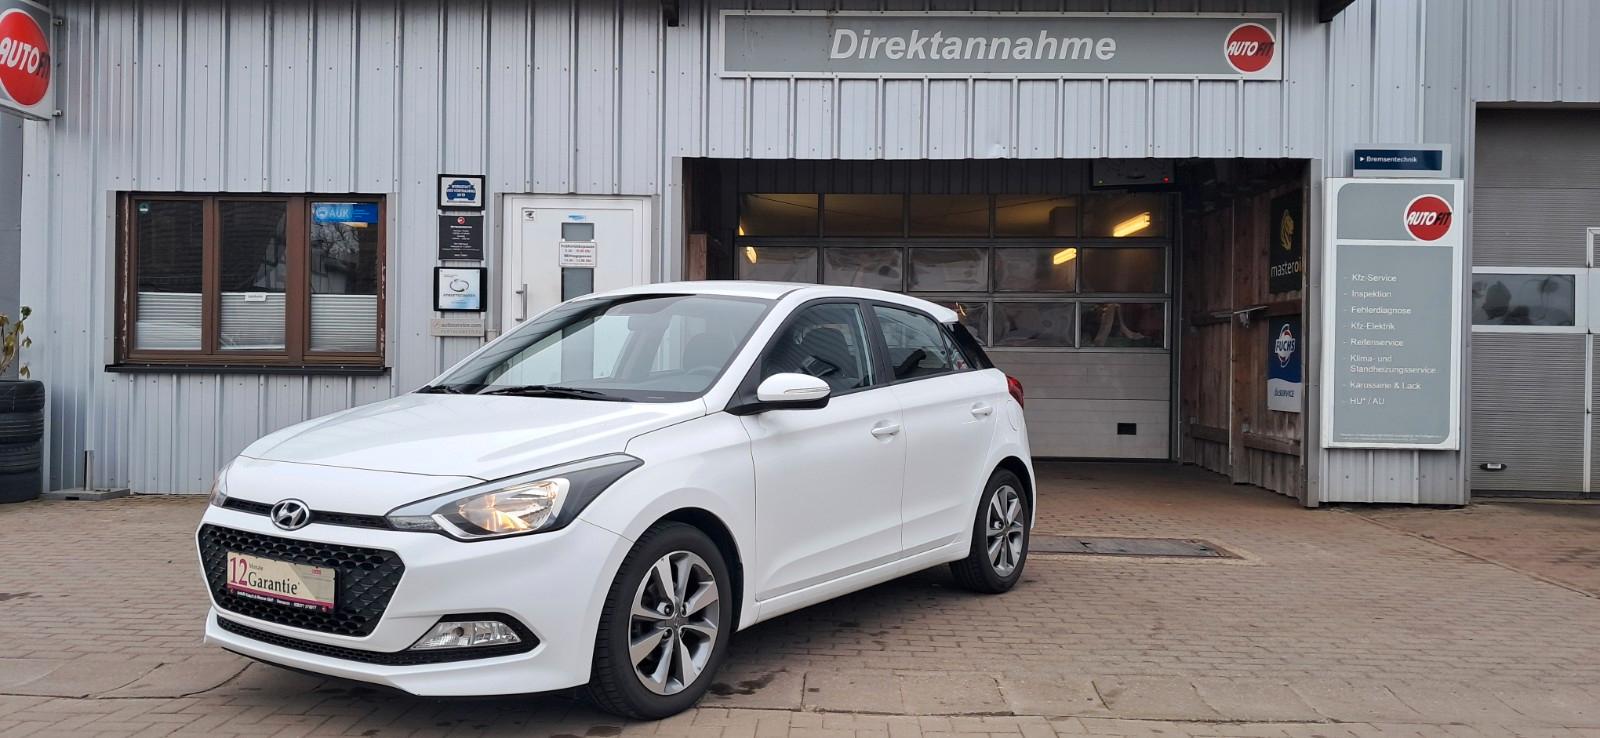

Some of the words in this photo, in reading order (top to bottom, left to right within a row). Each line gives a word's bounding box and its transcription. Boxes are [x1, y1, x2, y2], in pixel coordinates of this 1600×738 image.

[831, 28, 1117, 60] Direktannahme
[1227, 41, 1275, 56] AUTOFIT
[1406, 211, 1452, 226] AUTOFIT
[1352, 273, 1397, 282] Kfz-Service
[1351, 289, 1392, 300] Inspektion
[1351, 305, 1412, 315] Fehlerdiagnose
[1351, 321, 1395, 330] Kfz-Elektrik
[1275, 340, 1295, 352] FUCHS
[1350, 337, 1404, 347] Reifenservice
[1350, 354, 1376, 362] Klima-
[1402, 382, 1422, 390] Lack
[230, 557, 248, 586] 12
